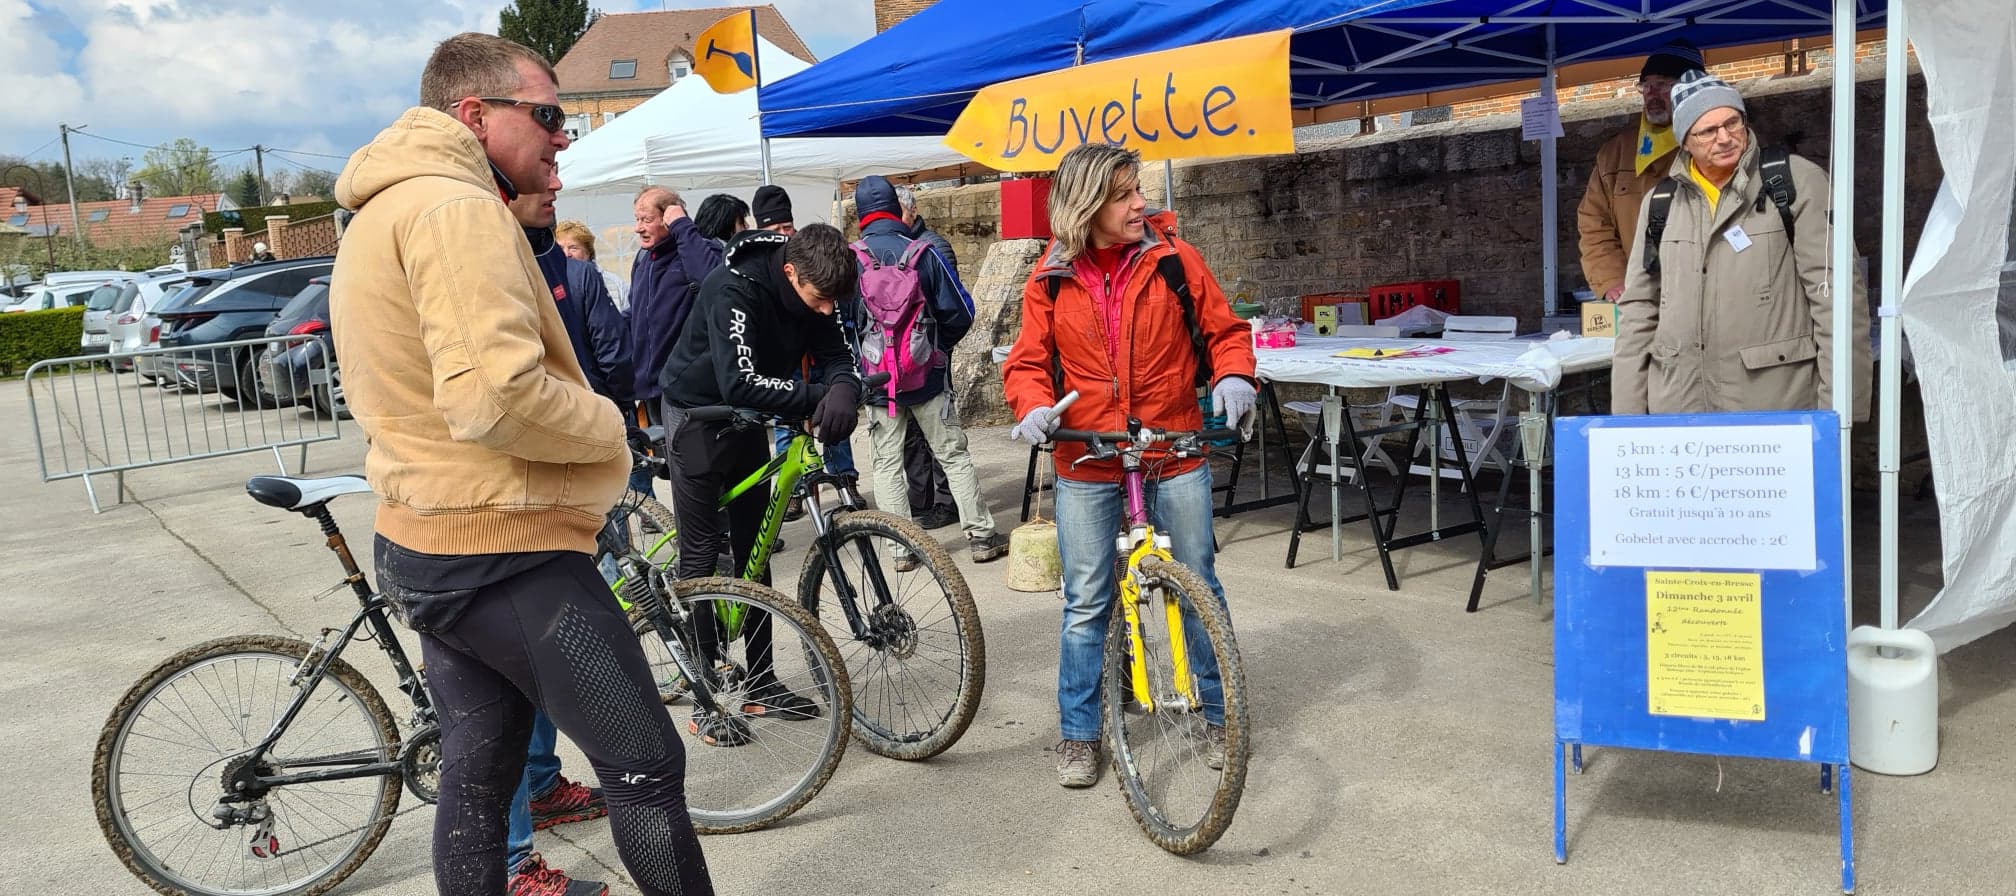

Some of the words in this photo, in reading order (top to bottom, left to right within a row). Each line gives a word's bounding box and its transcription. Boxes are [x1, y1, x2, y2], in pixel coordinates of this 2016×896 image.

[1617, 445, 1626, 457] 5
[1631, 442, 1655, 455] km
[1670, 446, 1679, 457] 4
[1684, 441, 1782, 457] €/personne
[1615, 467, 1631, 479] 13
[1635, 463, 1660, 477] km
[1675, 466, 1684, 479] 5
[1689, 463, 1786, 479] €/personne
[1615, 485, 1631, 499] 18
[1636, 485, 1660, 499] km
[1675, 486, 1686, 499] 6
[1690, 485, 1788, 501] €/personne
[1629, 507, 1675, 518] Gratuit
[1678, 507, 1725, 520] jusqu'à
[1729, 509, 1744, 518] 10
[1747, 510, 1772, 518] ans
[1615, 533, 1663, 544] Gobelet
[1667, 536, 1696, 545] avec
[1700, 534, 1757, 546] accroche
[1769, 535, 1788, 546] 2€
[1656, 591, 1714, 601] Dimanche
[1716, 593, 1724, 603] 3
[1726, 593, 1753, 602] avril
